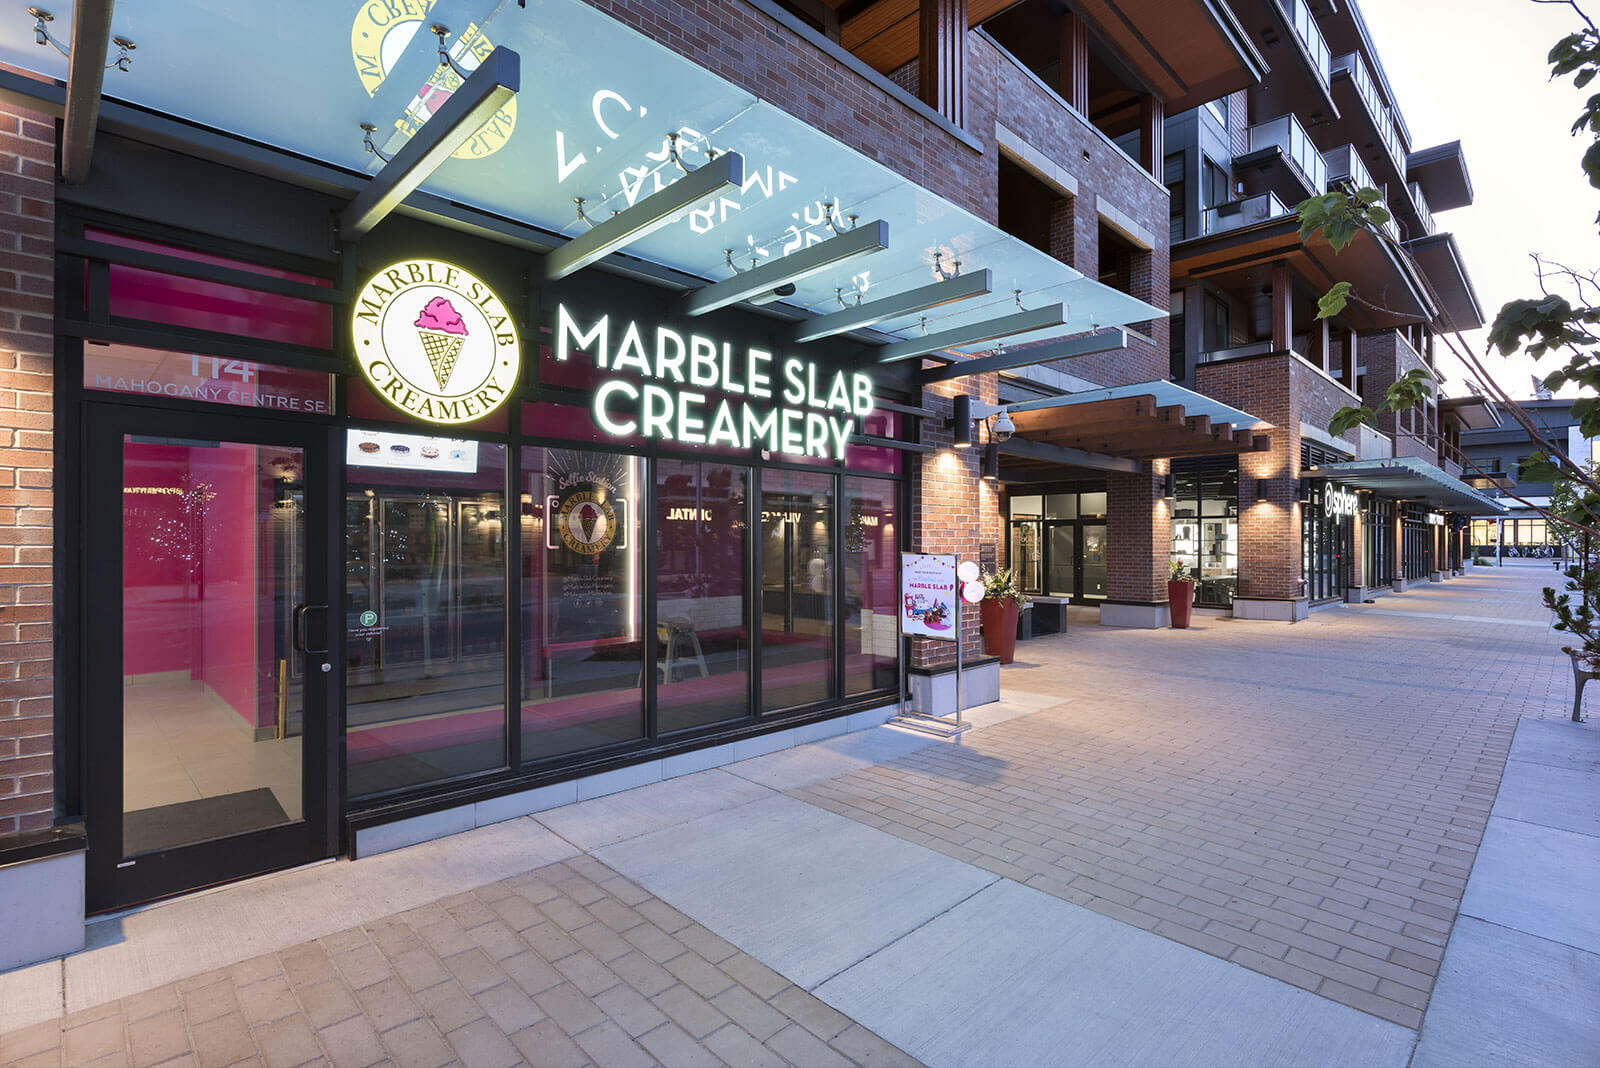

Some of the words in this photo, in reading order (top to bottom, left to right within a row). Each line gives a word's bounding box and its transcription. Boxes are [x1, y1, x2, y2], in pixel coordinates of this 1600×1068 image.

[356, 263, 460, 326] MARBLE
[467, 282, 514, 347] SLAB
[191, 354, 255, 383] 114
[556, 302, 773, 399] MARBLE
[782, 357, 875, 416] SLAB
[95, 374, 222, 401] MAHOGANY
[227, 391, 300, 410] CENTRE
[303, 399, 327, 413] SE
[369, 360, 505, 419] CREAMERY
[594, 380, 854, 460] CREAMERY
[586, 470, 617, 494] Station
[364, 613, 374, 624] P
